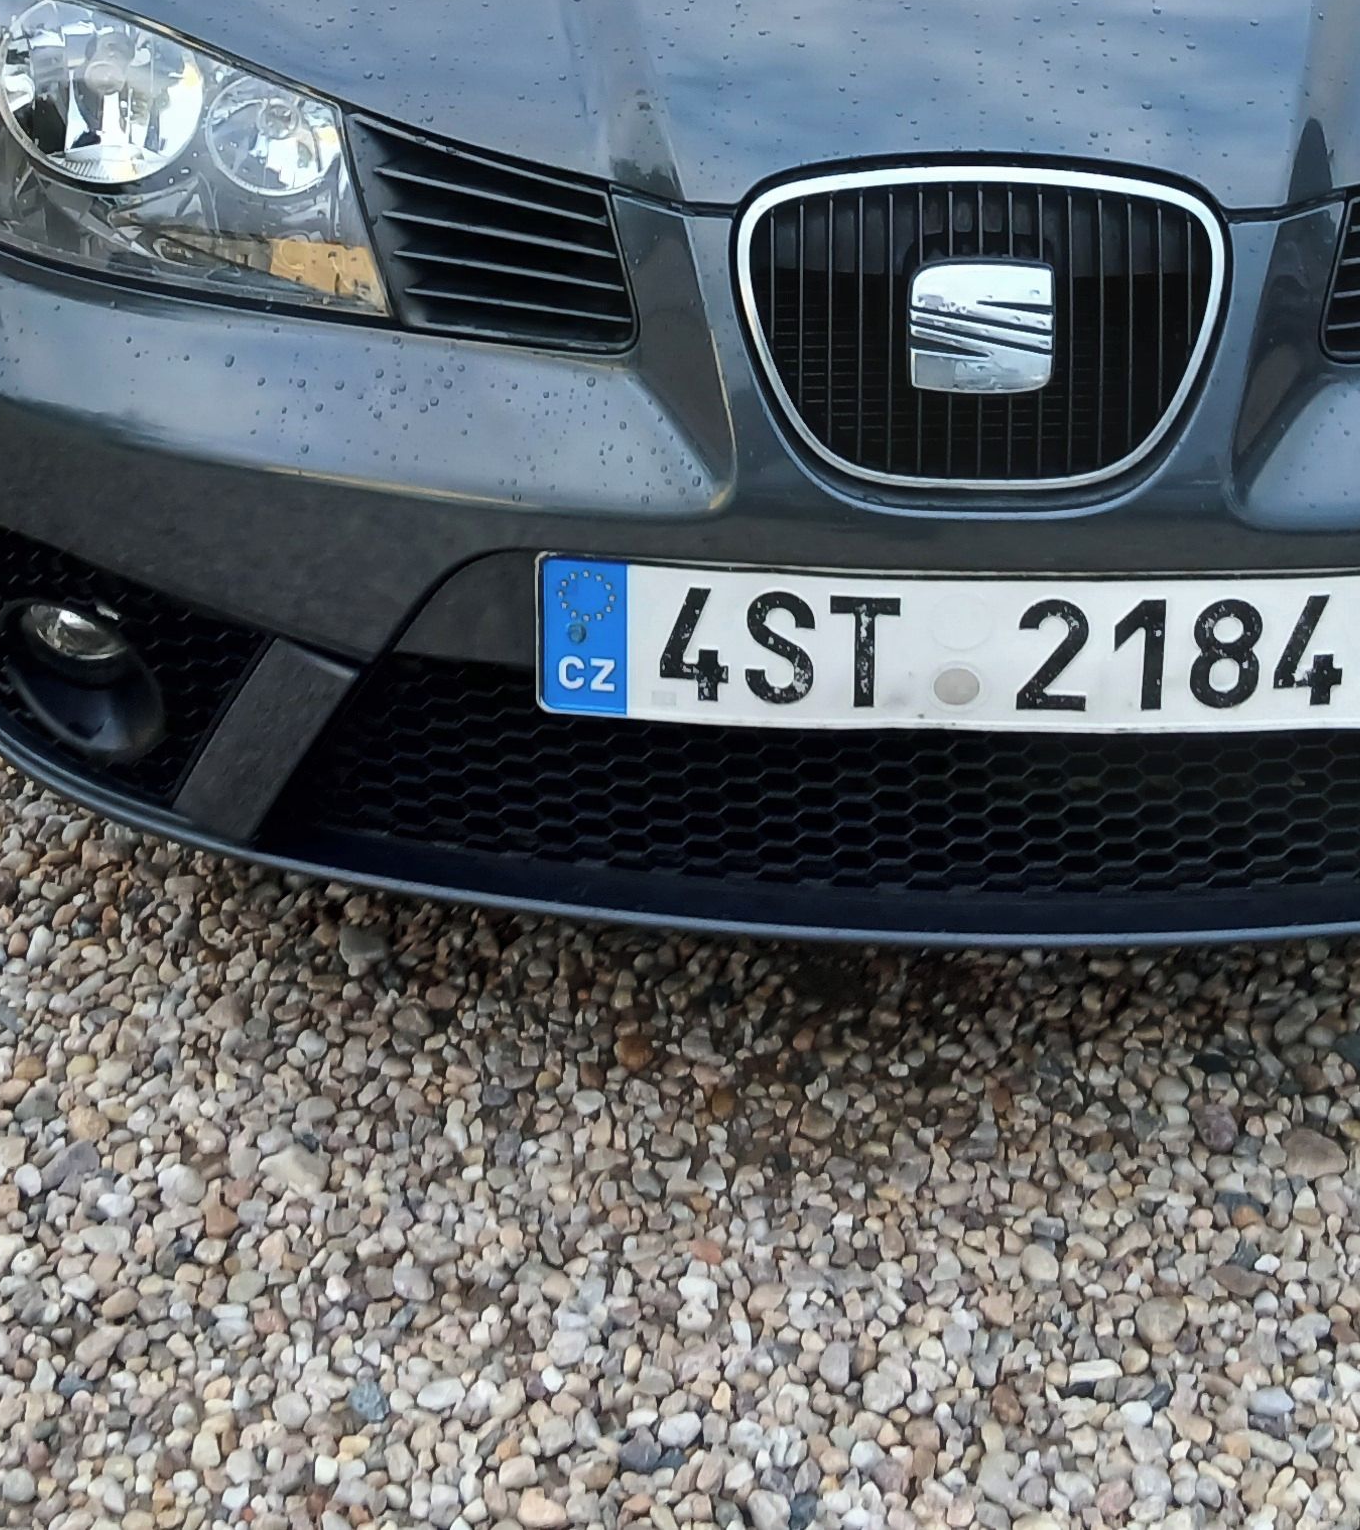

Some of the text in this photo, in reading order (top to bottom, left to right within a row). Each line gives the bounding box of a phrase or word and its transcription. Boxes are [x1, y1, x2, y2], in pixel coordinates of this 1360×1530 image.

[558, 587, 1344, 712] CZ 4ST 2184
